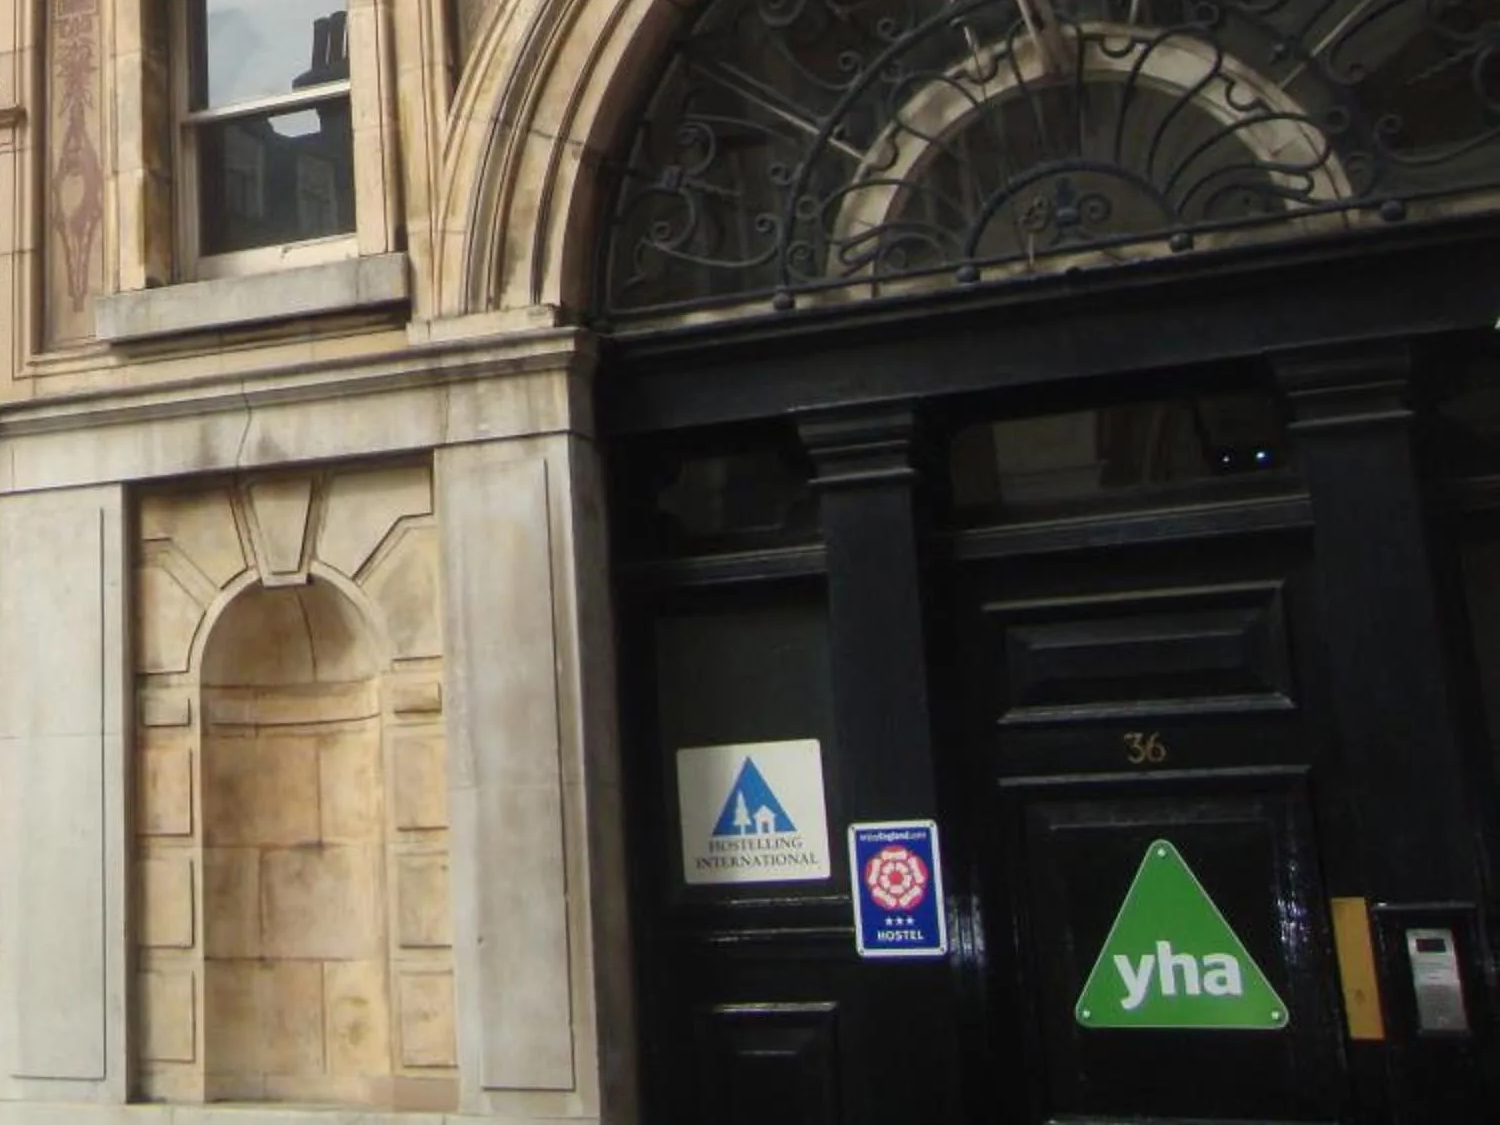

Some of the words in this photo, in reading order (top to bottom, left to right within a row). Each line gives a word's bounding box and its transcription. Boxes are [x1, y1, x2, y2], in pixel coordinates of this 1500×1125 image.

[1123, 730, 1167, 764] 36
[708, 835, 804, 853] HOSTELLING
[695, 851, 819, 870] INTERNATIONAL
[877, 929, 925, 941] HOSTEL
[1113, 940, 1244, 1010] yha
